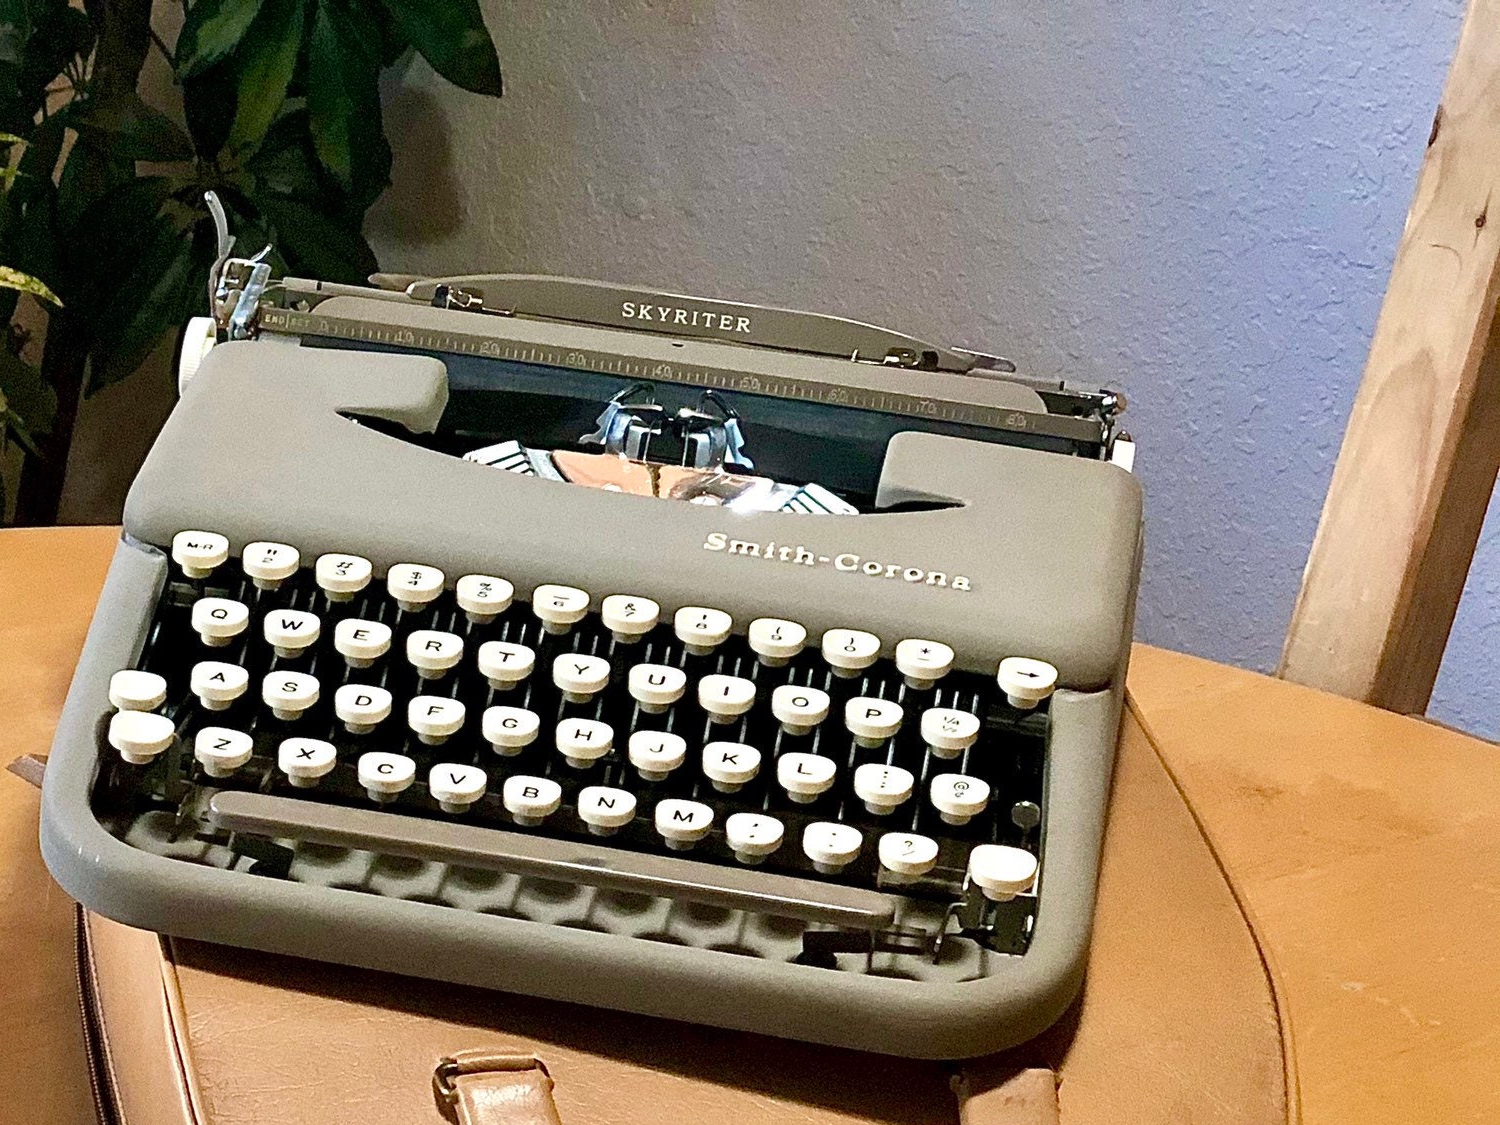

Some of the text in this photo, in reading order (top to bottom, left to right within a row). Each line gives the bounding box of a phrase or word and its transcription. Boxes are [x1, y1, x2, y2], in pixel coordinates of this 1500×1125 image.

[622, 301, 751, 333] SKYRITER
[481, 340, 500, 356] 20
[568, 352, 586, 367] 30
[655, 364, 673, 379] 40
[742, 376, 759, 392] 50
[919, 400, 938, 416] 70
[702, 532, 973, 592] Smith-Corona
[211, 609, 227, 619] Q
[282, 619, 303, 630] W
[353, 630, 369, 640] E
[425, 641, 442, 651] R
[499, 652, 515, 662] T
[575, 664, 589, 675] Y
[648, 674, 665, 685] U
[724, 686, 729, 696] I
[792, 697, 809, 707] O
[866, 709, 881, 718] P
[210, 673, 225, 682] A
[282, 682, 298, 692] S
[355, 695, 372, 705] D
[427, 706, 444, 715] F
[502, 718, 518, 728] G
[575, 729, 592, 741] H
[650, 744, 663, 752] J
[722, 753, 738, 764] K
[798, 763, 810, 774] L
[214, 738, 231, 750] Z
[297, 748, 315, 759] X
[378, 764, 393, 774] C
[450, 773, 466, 784] V
[522, 787, 539, 798] B
[598, 797, 615, 808] N
[673, 810, 693, 822] M
